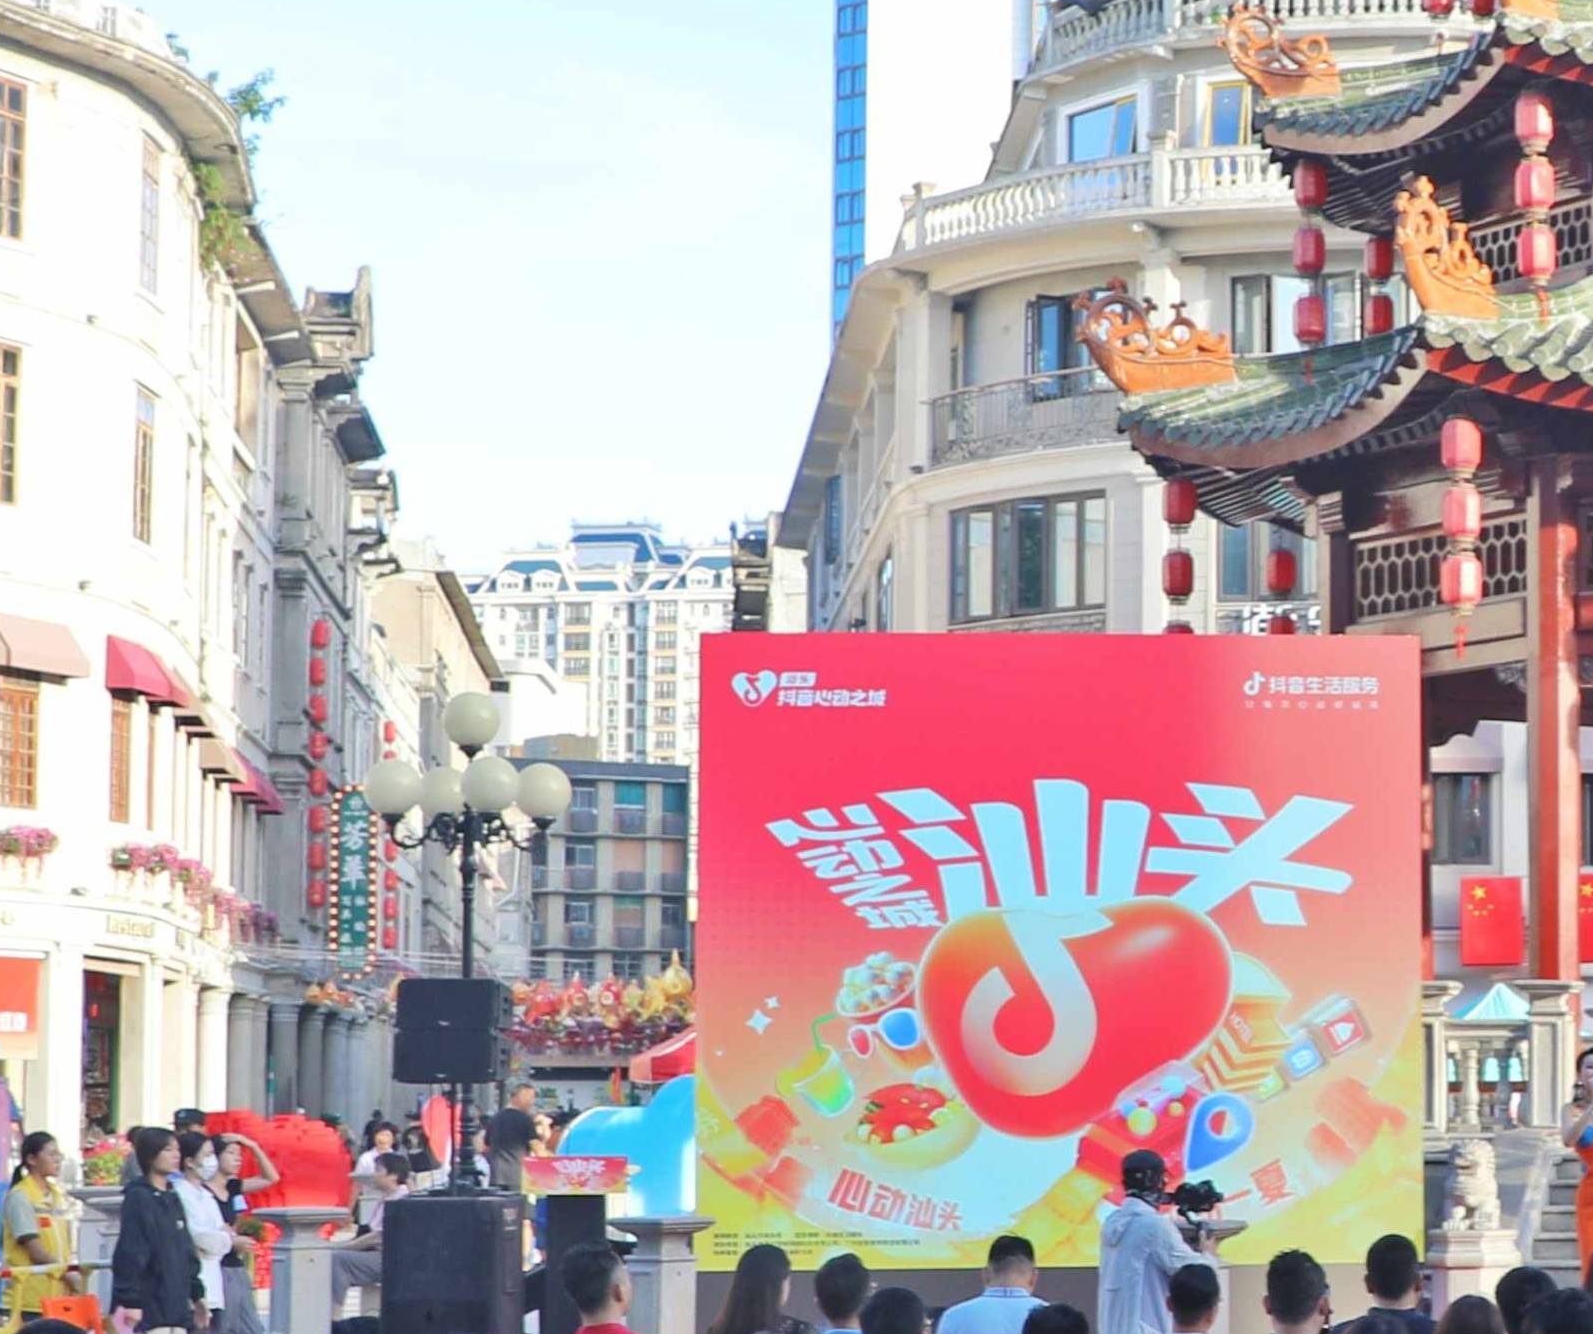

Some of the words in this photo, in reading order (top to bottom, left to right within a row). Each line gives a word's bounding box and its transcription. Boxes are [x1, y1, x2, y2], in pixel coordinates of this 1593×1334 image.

[1268, 675, 1380, 695] 抖音生活服务
[876, 777, 1357, 928] 汕头
[826, 1167, 965, 1232] 心动汕头
